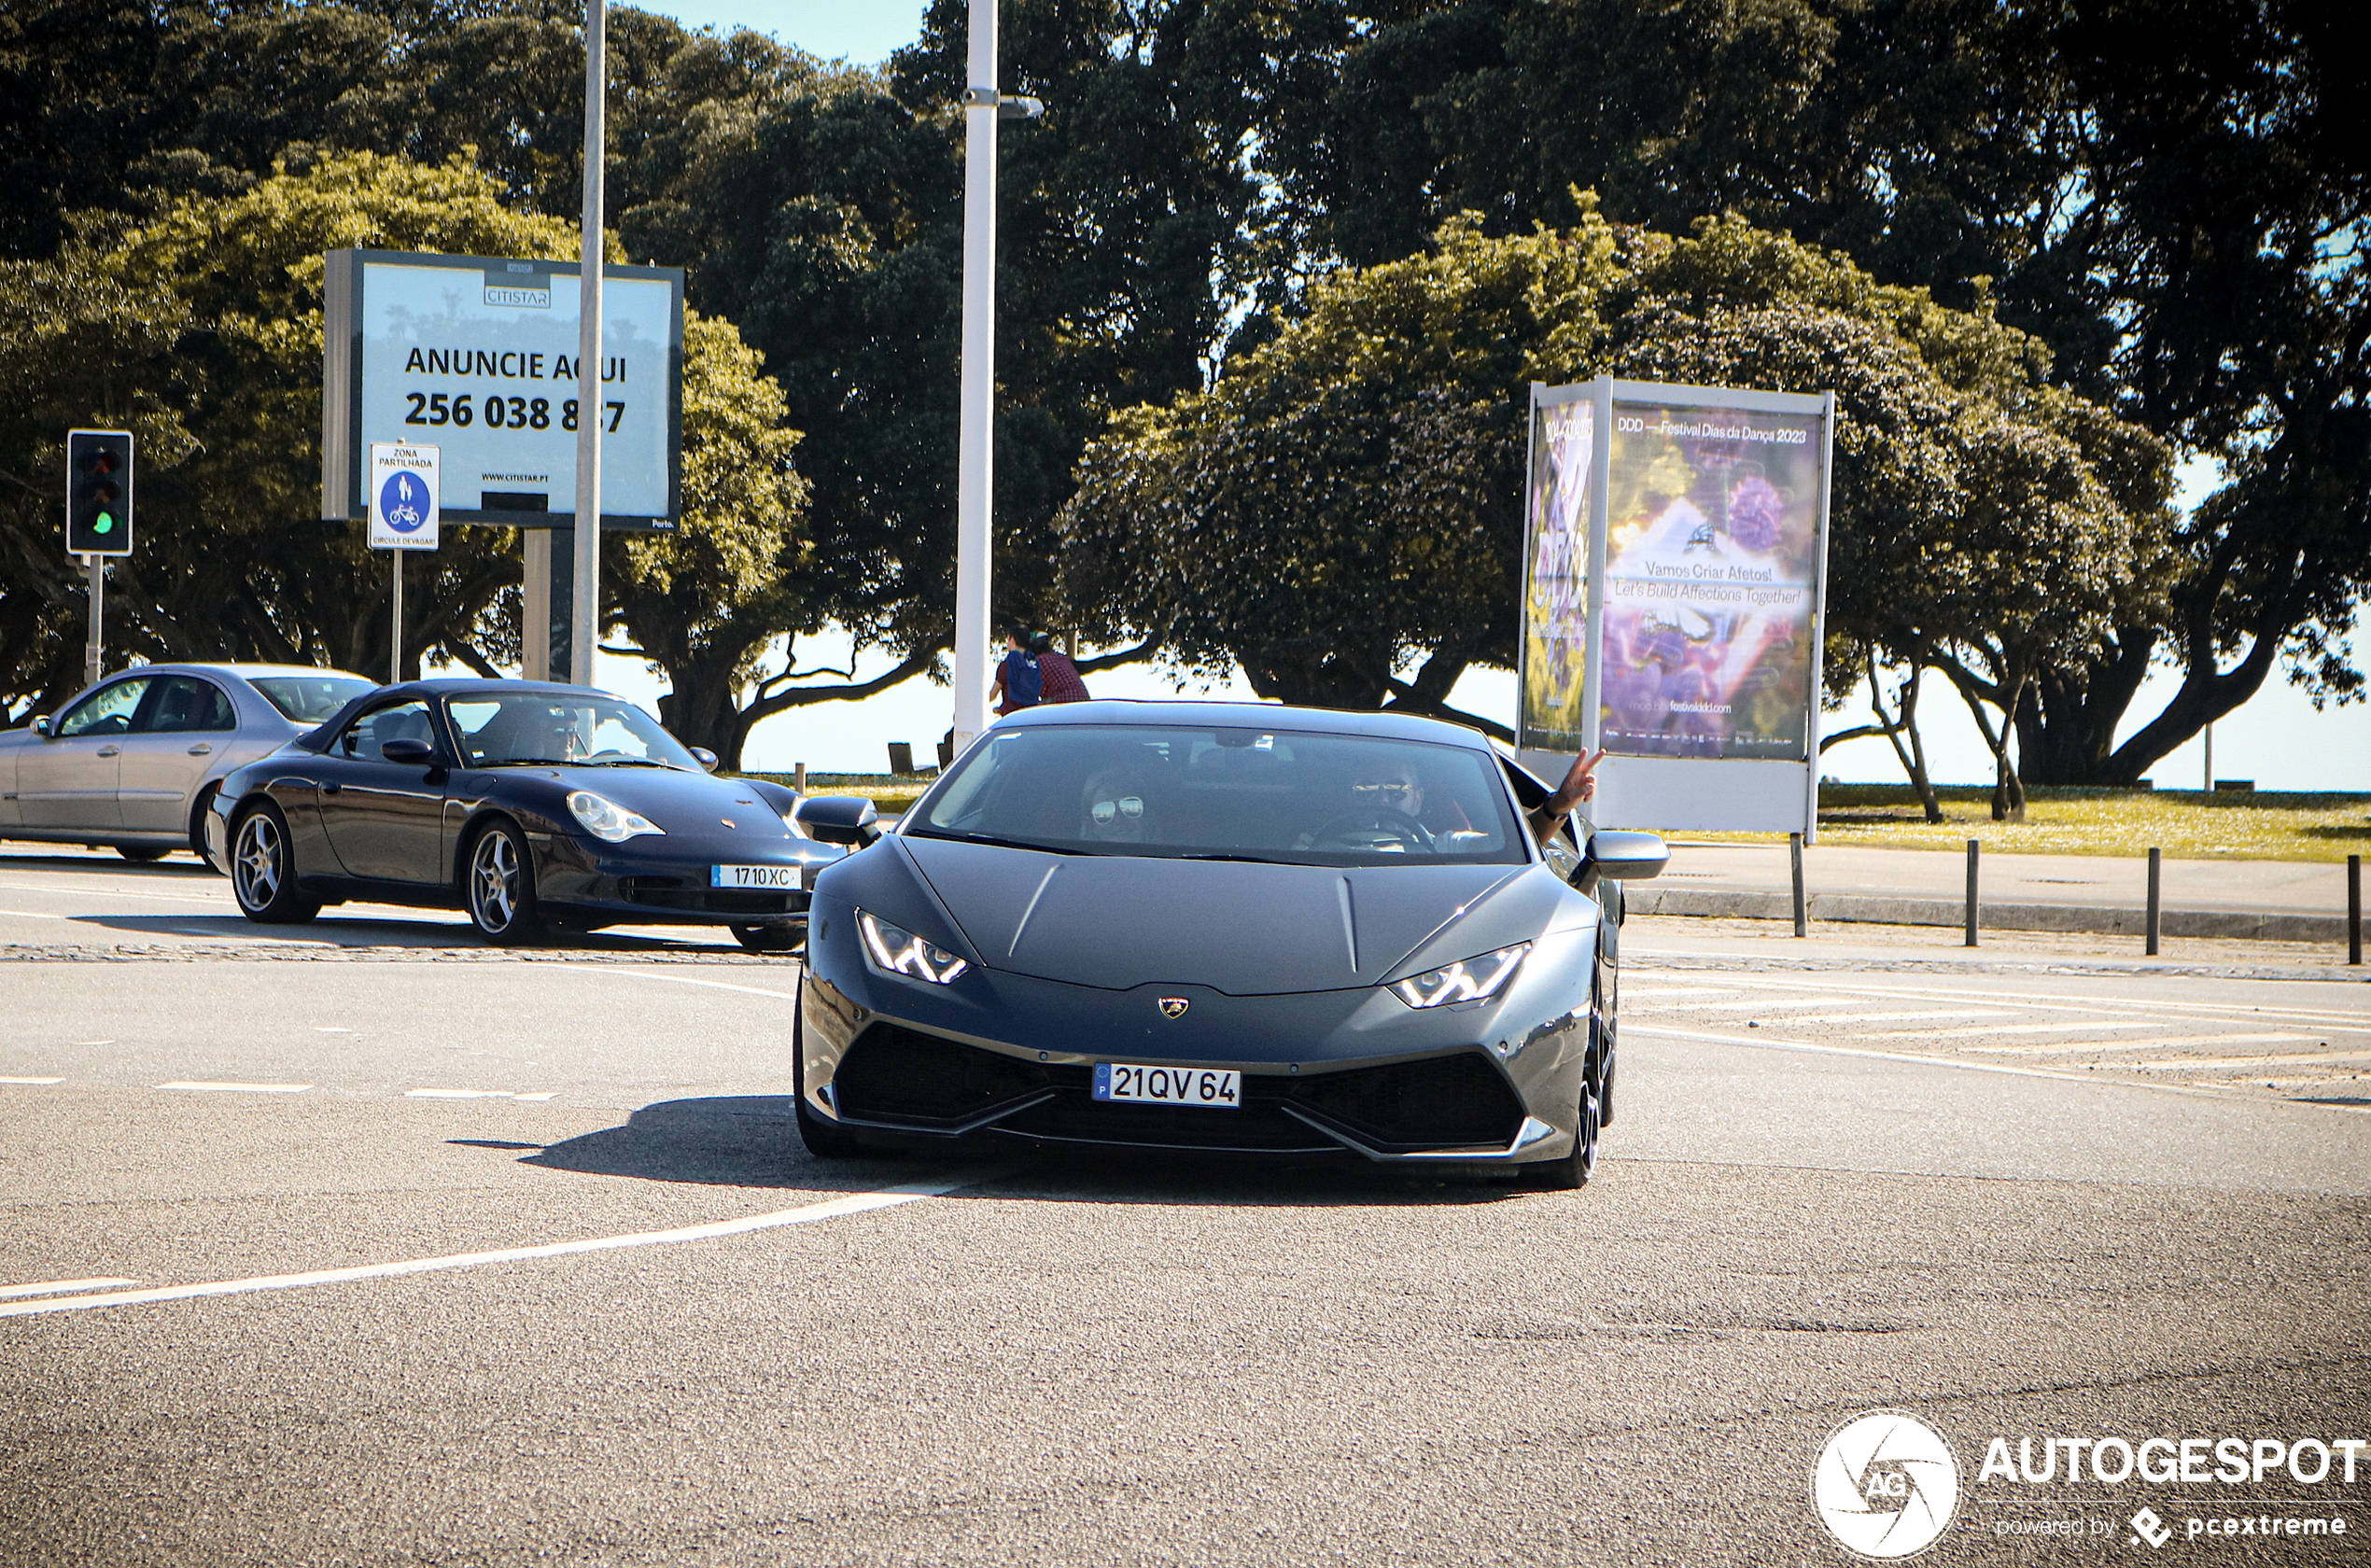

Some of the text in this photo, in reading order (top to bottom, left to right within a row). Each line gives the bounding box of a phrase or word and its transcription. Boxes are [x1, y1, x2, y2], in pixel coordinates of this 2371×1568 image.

[487, 289, 548, 305] CITISTAR
[405, 347, 625, 384] ANUNCIE AUI
[405, 393, 625, 434] 256 038 87
[1619, 417, 1644, 433] DDD
[1661, 421, 1701, 436] Festival
[1702, 424, 1725, 439] Dias
[1727, 425, 1741, 440] da
[1742, 427, 1775, 444] Dança
[1776, 428, 1807, 444] 2023
[394, 449, 417, 458] ZONA
[379, 458, 433, 469] PARTILHADA
[482, 472, 549, 483] WWW.CITISTAR.PT
[373, 537, 401, 545] CIRCULE
[1646, 561, 1773, 582] Vamos Criar Afetos!
[1615, 581, 1802, 606] Let's Build Affections Together!
[1670, 699, 1732, 714] festivalddd.com
[1099, 1085, 1106, 1094] P
